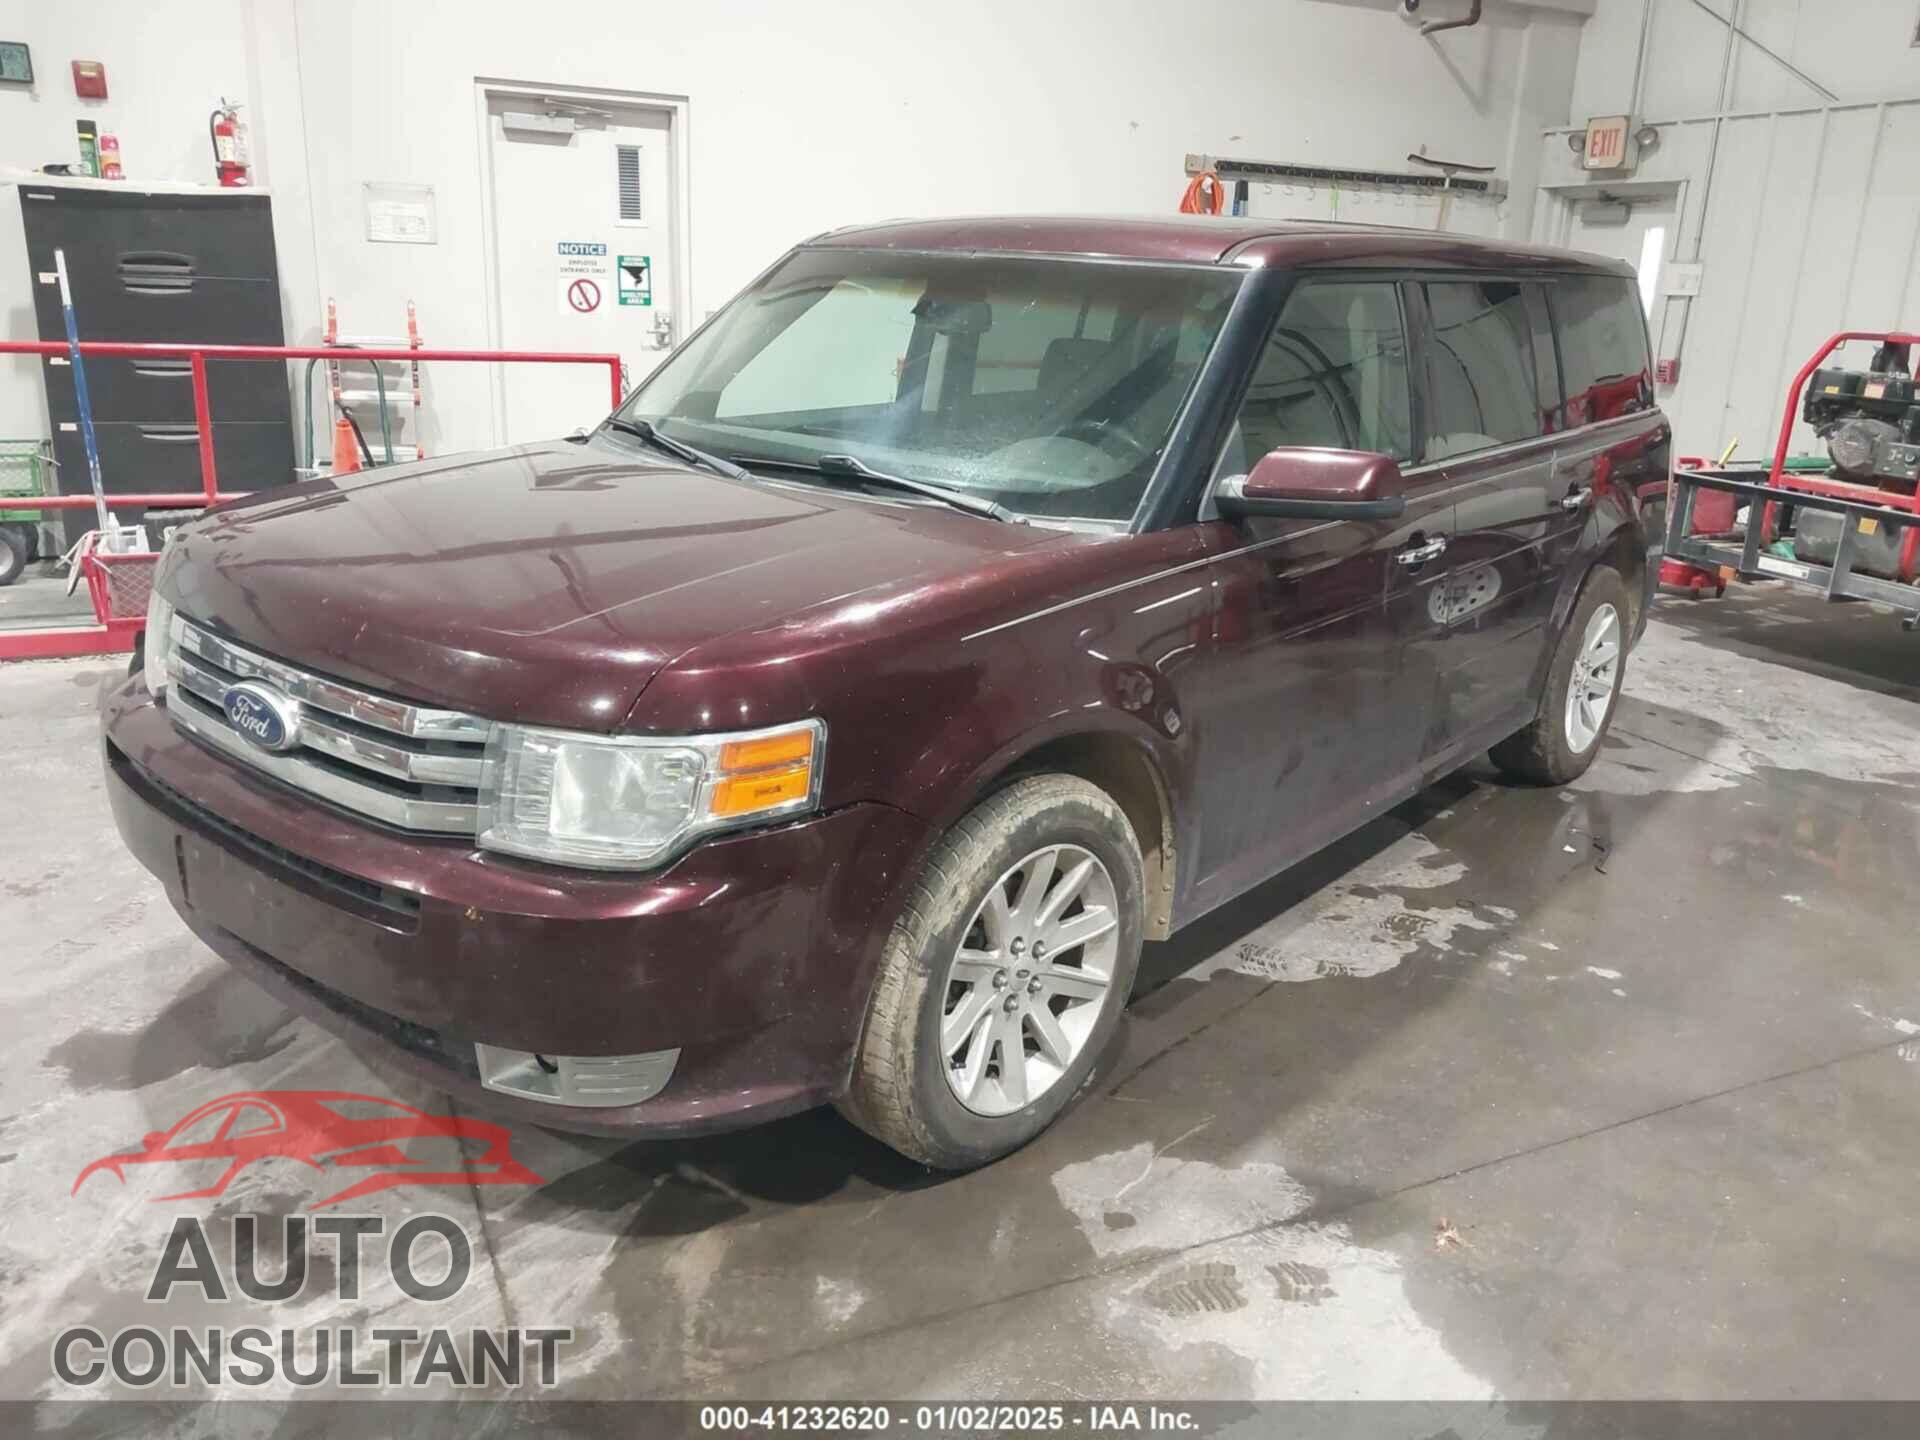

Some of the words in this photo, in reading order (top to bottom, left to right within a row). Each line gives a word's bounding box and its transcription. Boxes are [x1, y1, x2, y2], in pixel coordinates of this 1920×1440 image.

[1590, 129, 1621, 157] EXIT
[559, 243, 605, 255] NOTICE
[231, 694, 271, 738] Ford
